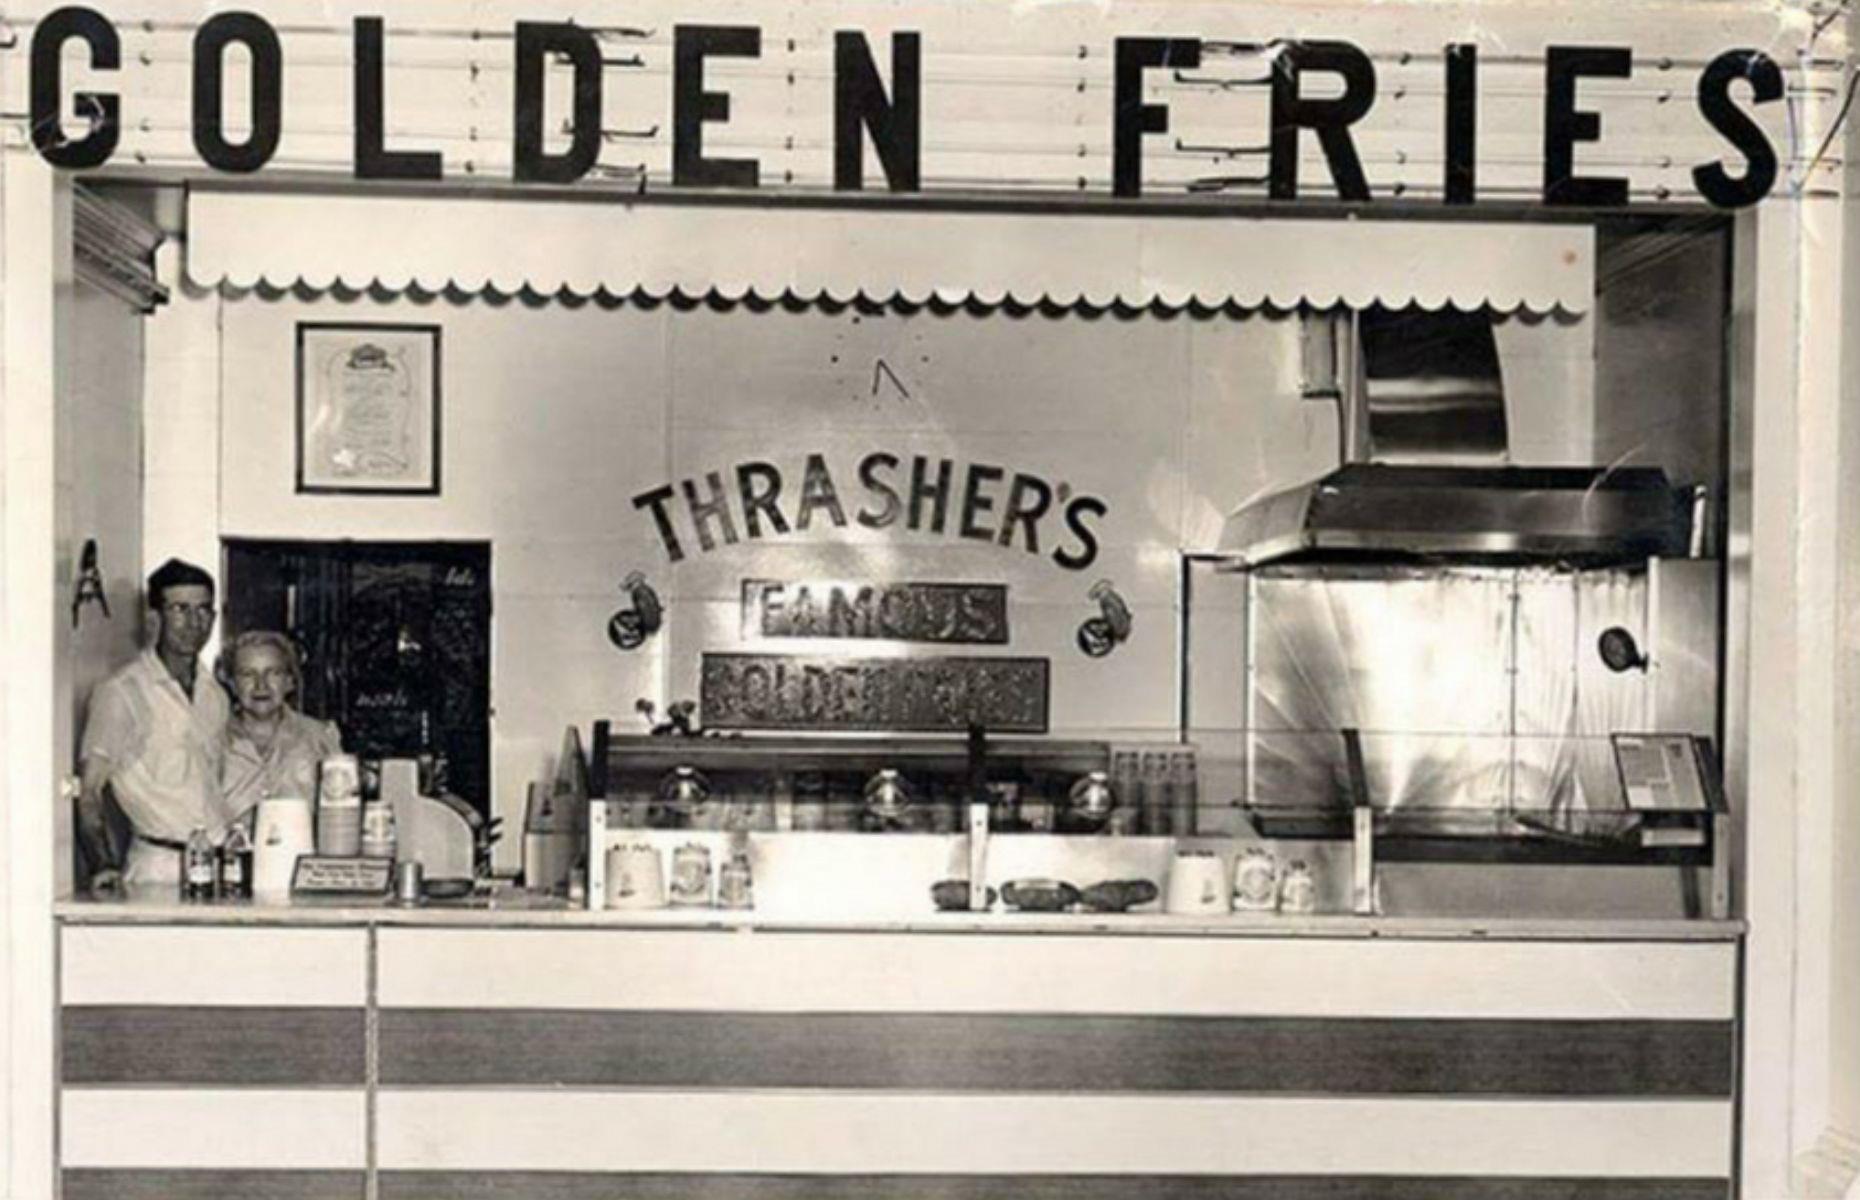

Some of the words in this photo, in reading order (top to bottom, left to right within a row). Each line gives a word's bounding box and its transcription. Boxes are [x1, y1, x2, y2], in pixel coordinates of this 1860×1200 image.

[29, 6, 921, 193] GOLDEN
[1110, 37, 1784, 208] FRIES
[632, 452, 1109, 571] THRASHER'S
[761, 583, 997, 640] FAMOUS
